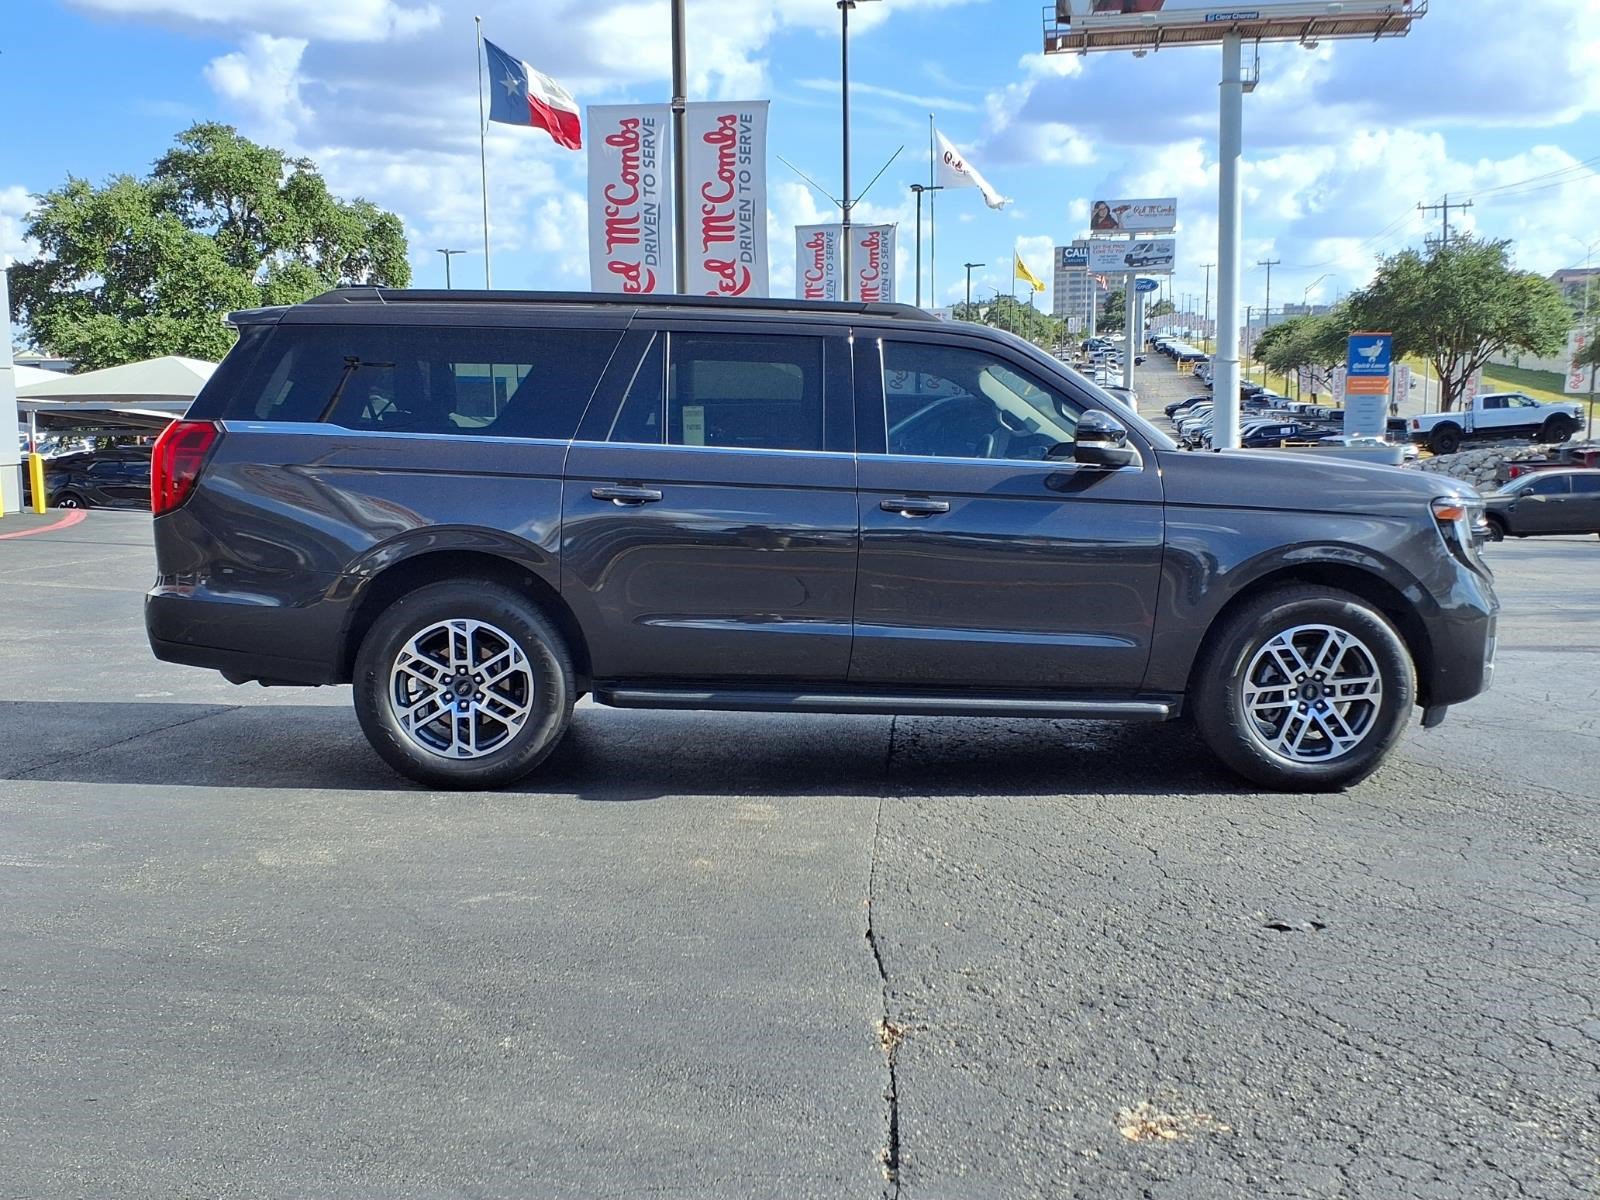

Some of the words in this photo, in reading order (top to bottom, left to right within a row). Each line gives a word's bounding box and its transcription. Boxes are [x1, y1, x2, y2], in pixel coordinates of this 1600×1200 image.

[643, 116, 656, 169] SERVE
[738, 112, 753, 165] SERVE
[604, 117, 641, 256] McCombs
[643, 173, 656, 197] TO
[701, 114, 738, 254] McCombs
[738, 170, 752, 194] TO
[643, 202, 658, 267] DRIVEN
[738, 199, 753, 264] DRIVEN
[826, 231, 834, 261] SERVE
[881, 230, 890, 260] SERVE
[826, 263, 834, 276] TO
[881, 261, 889, 275] TO
